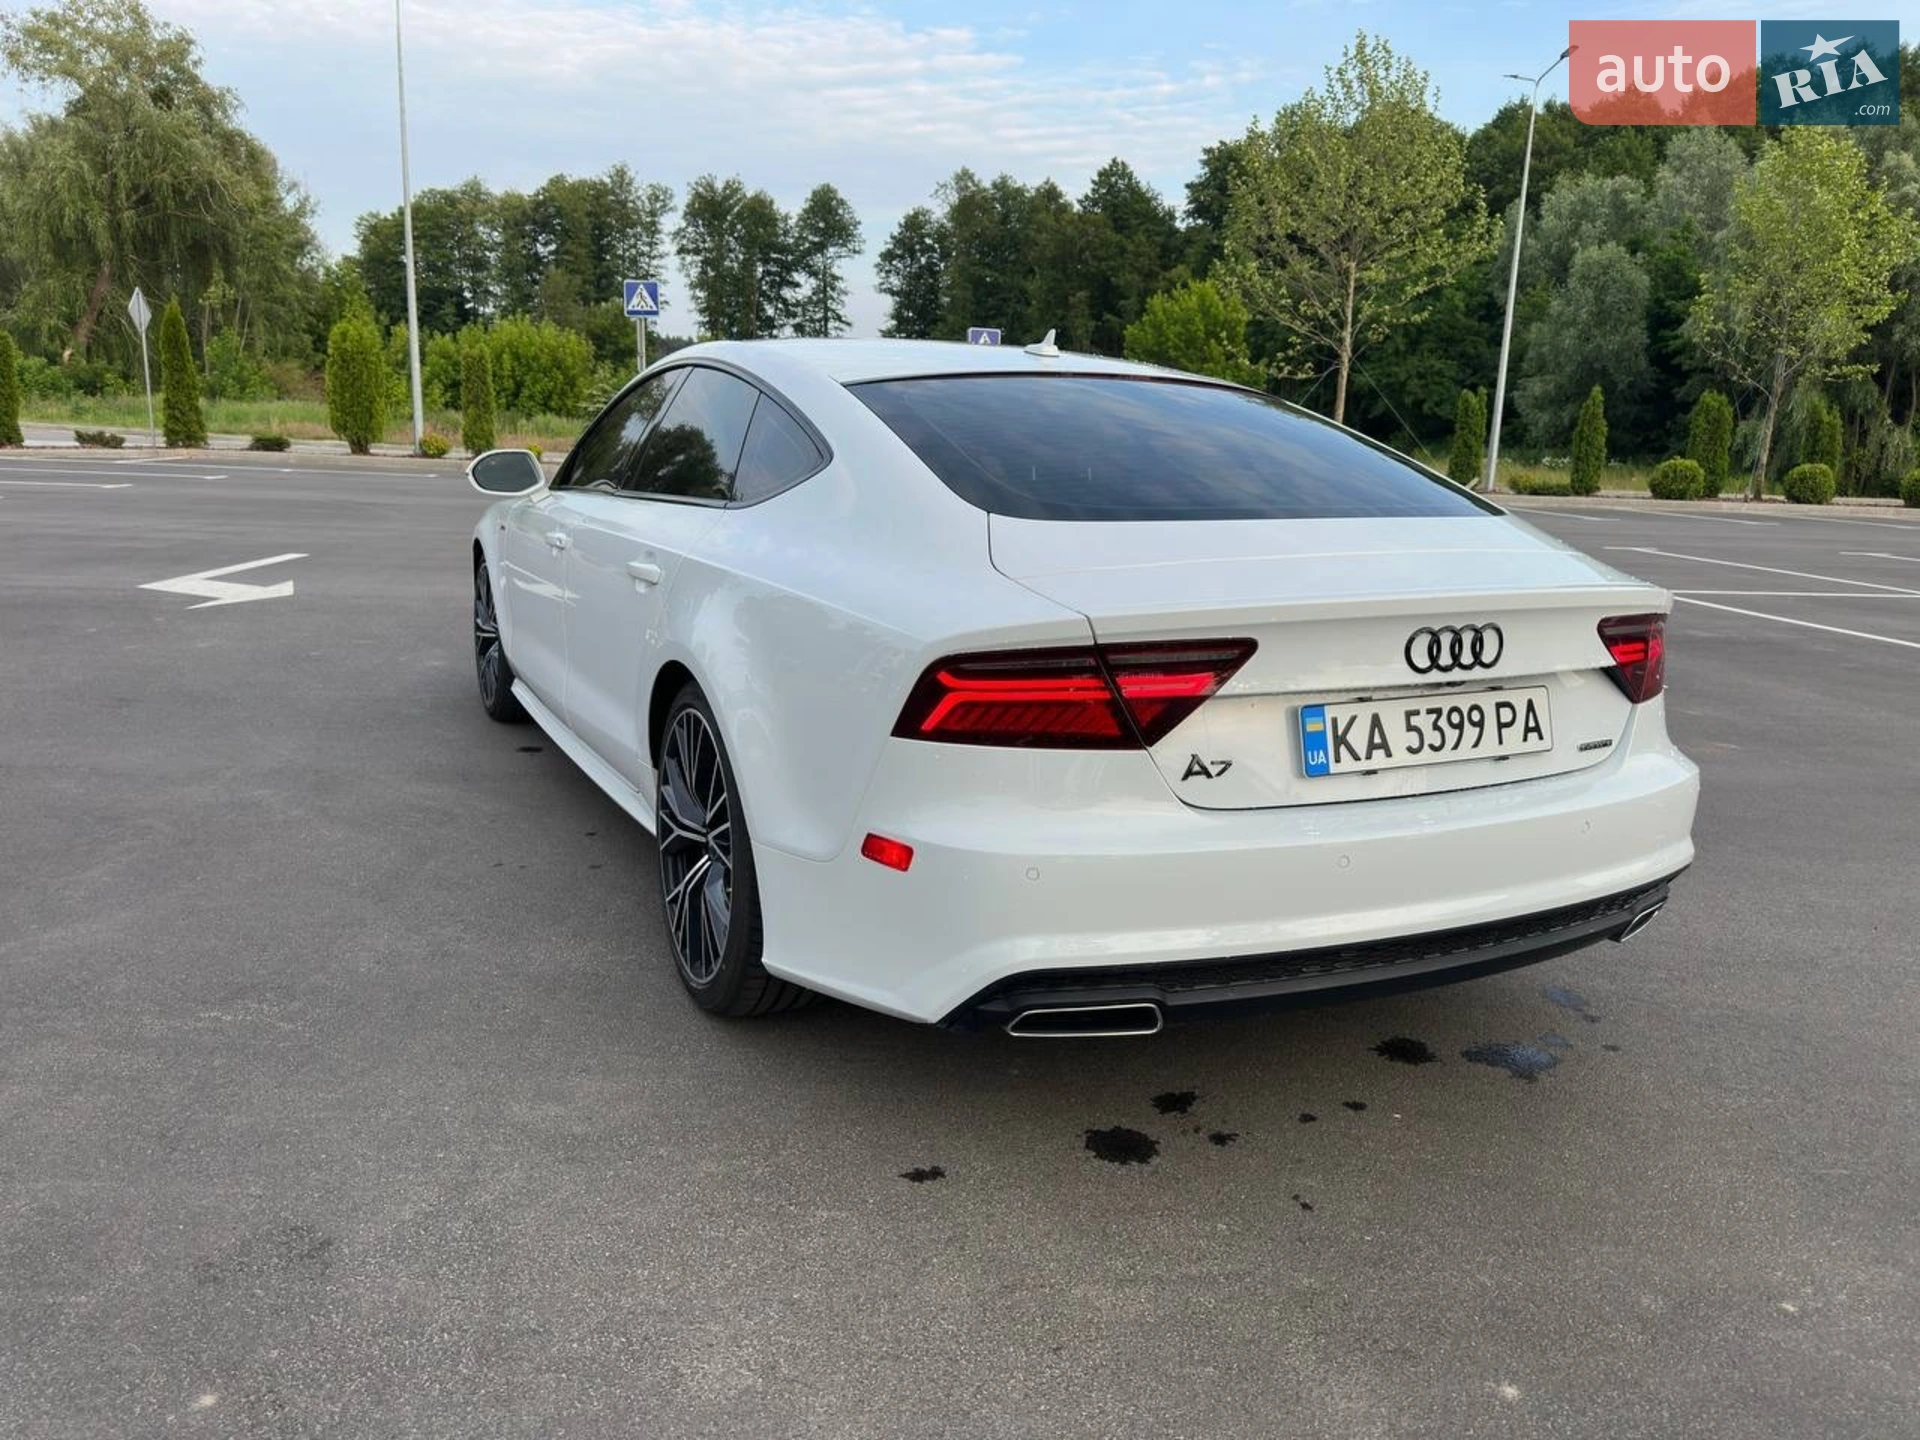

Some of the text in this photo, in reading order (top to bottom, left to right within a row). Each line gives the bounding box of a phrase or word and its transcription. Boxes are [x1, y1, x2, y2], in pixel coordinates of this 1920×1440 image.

[1330, 697, 1545, 764] KA 5399 PA
[1180, 753, 1233, 782] A7
[1308, 753, 1327, 766] UA
